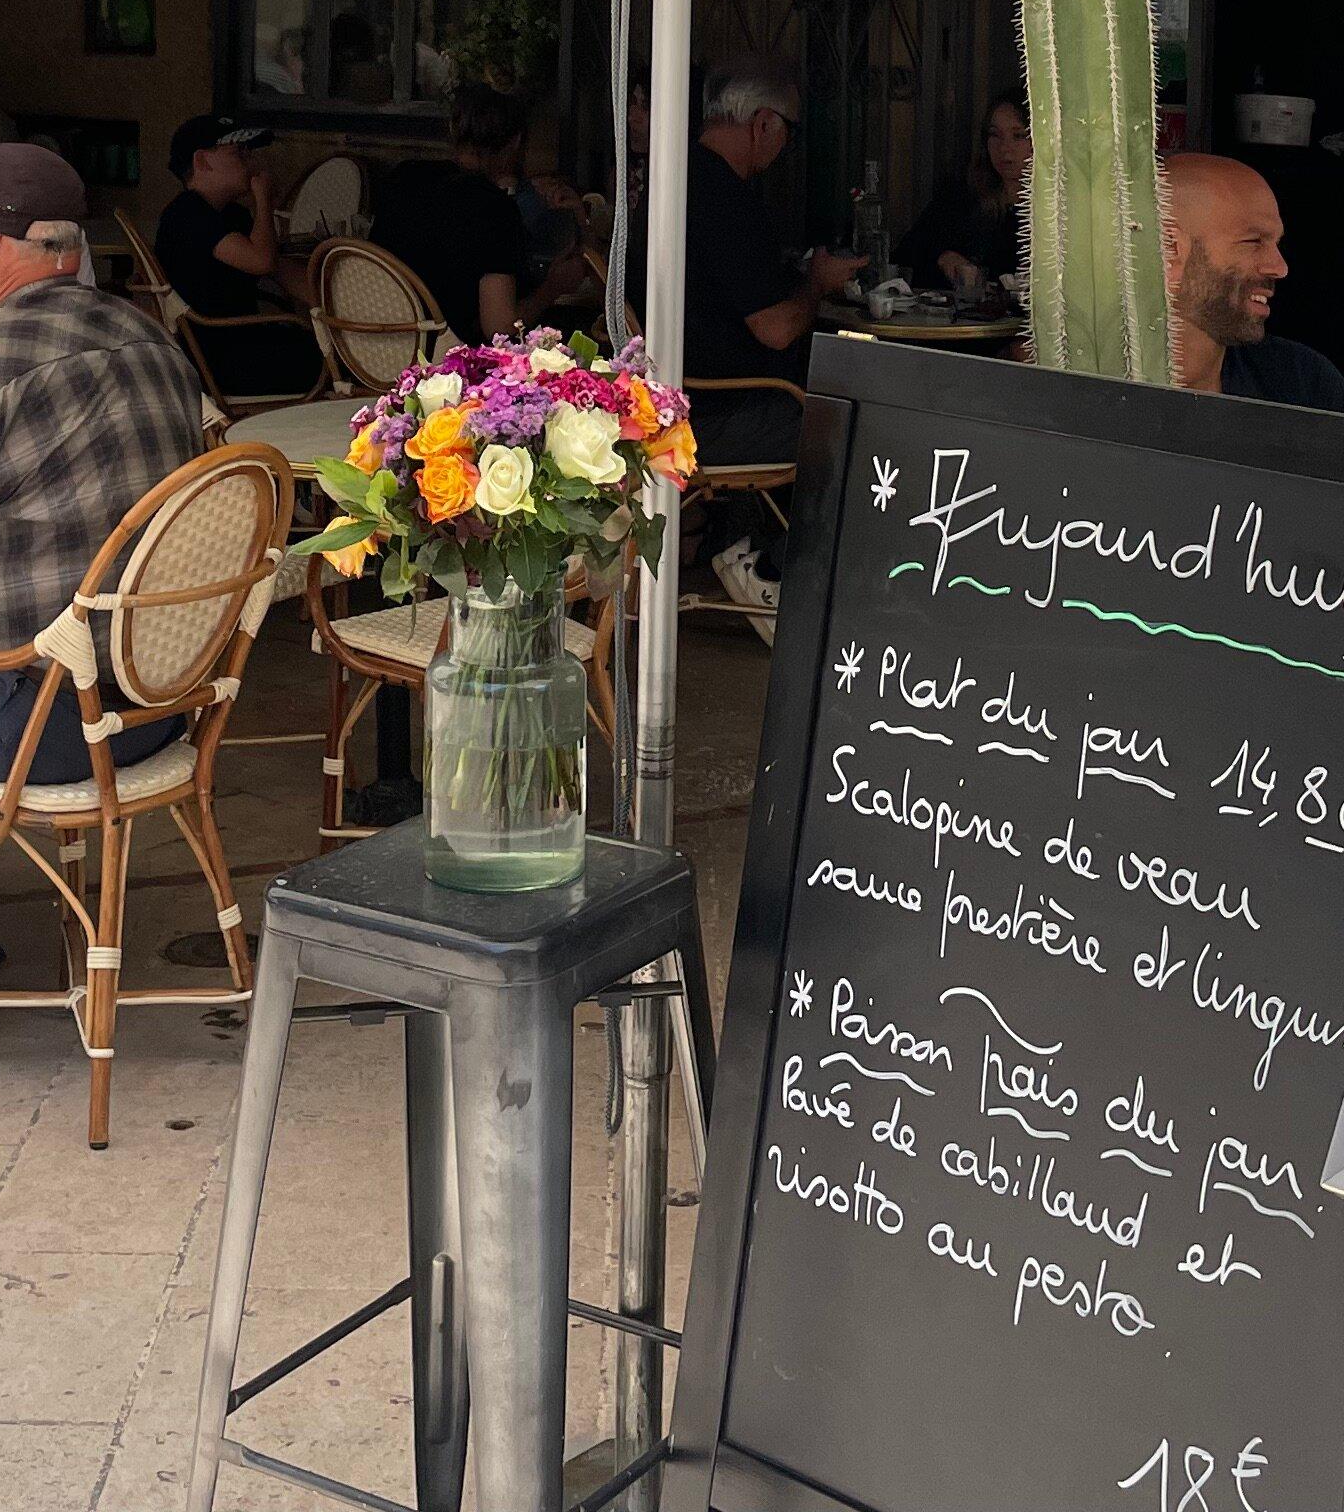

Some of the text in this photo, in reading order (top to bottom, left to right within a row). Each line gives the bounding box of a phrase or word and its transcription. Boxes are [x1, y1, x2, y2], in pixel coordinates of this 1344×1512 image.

[879, 646, 976, 710] Plat
[981, 671, 1058, 740] du
[808, 859, 923, 912] sauce
[1133, 925, 1186, 991] et
[1044, 818, 1100, 880] de
[1118, 854, 1261, 930] veau
[781, 1055, 1262, 1286] Pavé de cabillaud et
[1104, 1076, 1179, 1153] du
[768, 1146, 904, 1235] risotto
[928, 1223, 998, 1278] au
